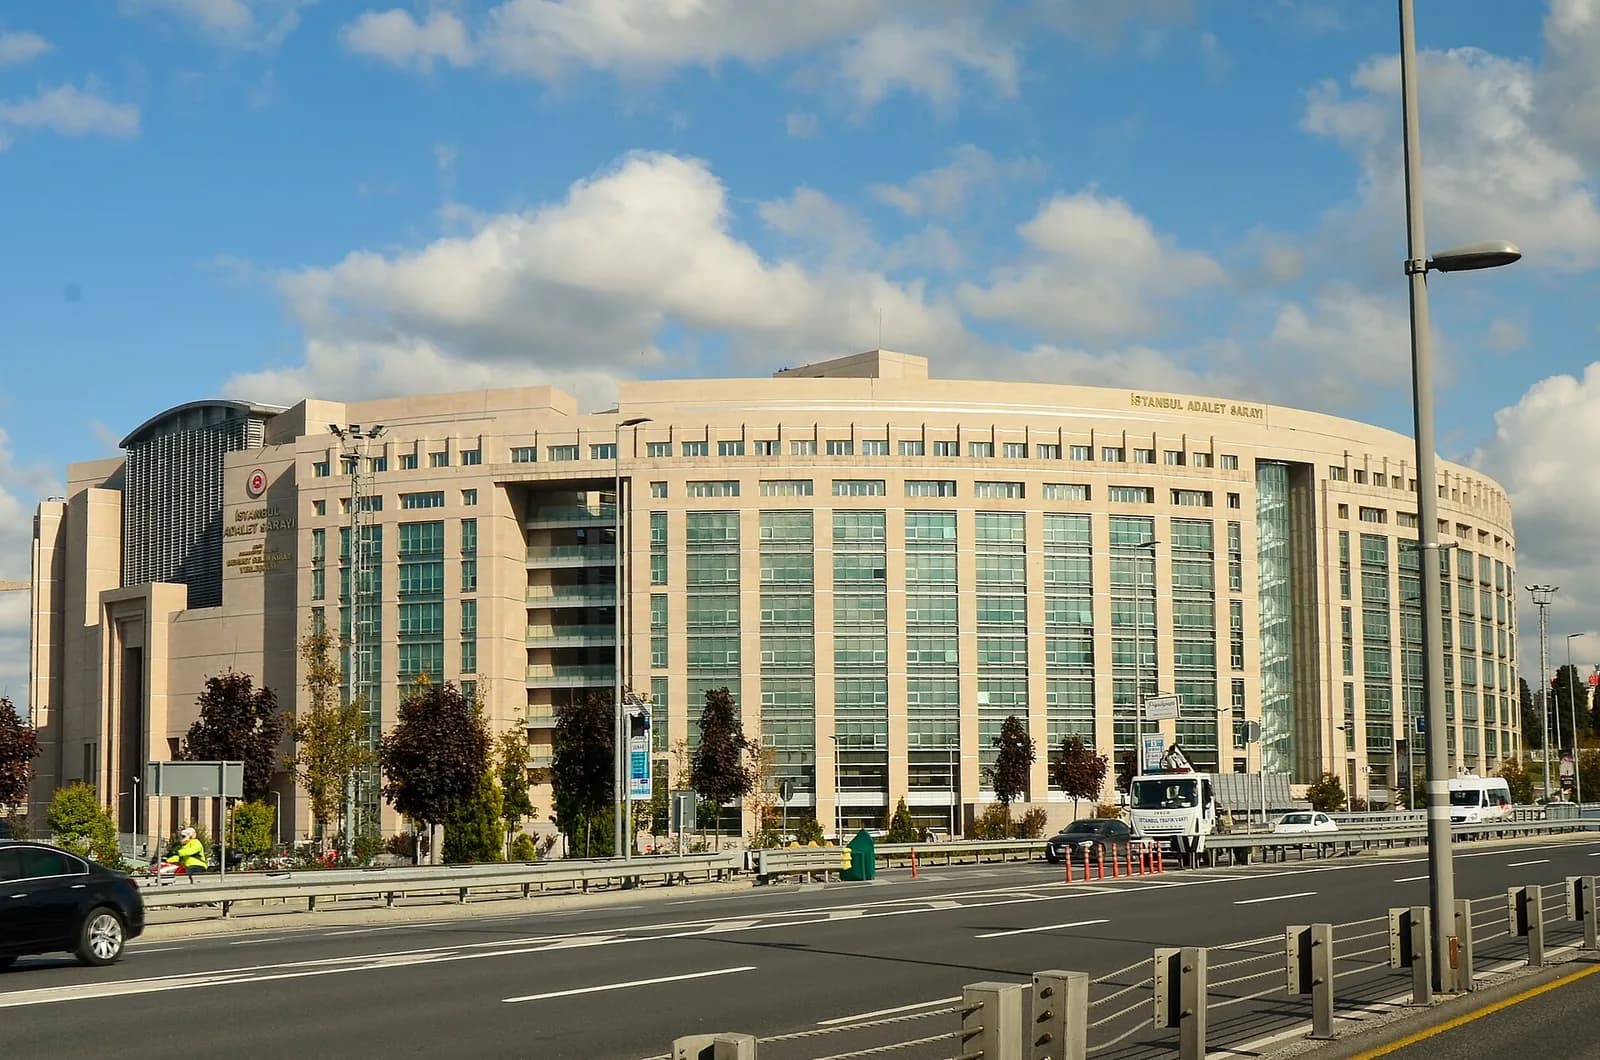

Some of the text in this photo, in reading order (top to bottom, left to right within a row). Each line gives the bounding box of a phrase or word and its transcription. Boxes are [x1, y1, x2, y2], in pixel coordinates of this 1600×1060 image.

[1187, 400, 1226, 414] ADALET
[1230, 405, 1263, 419] SARAYI
[224, 519, 296, 537] ADALET SARAYI
